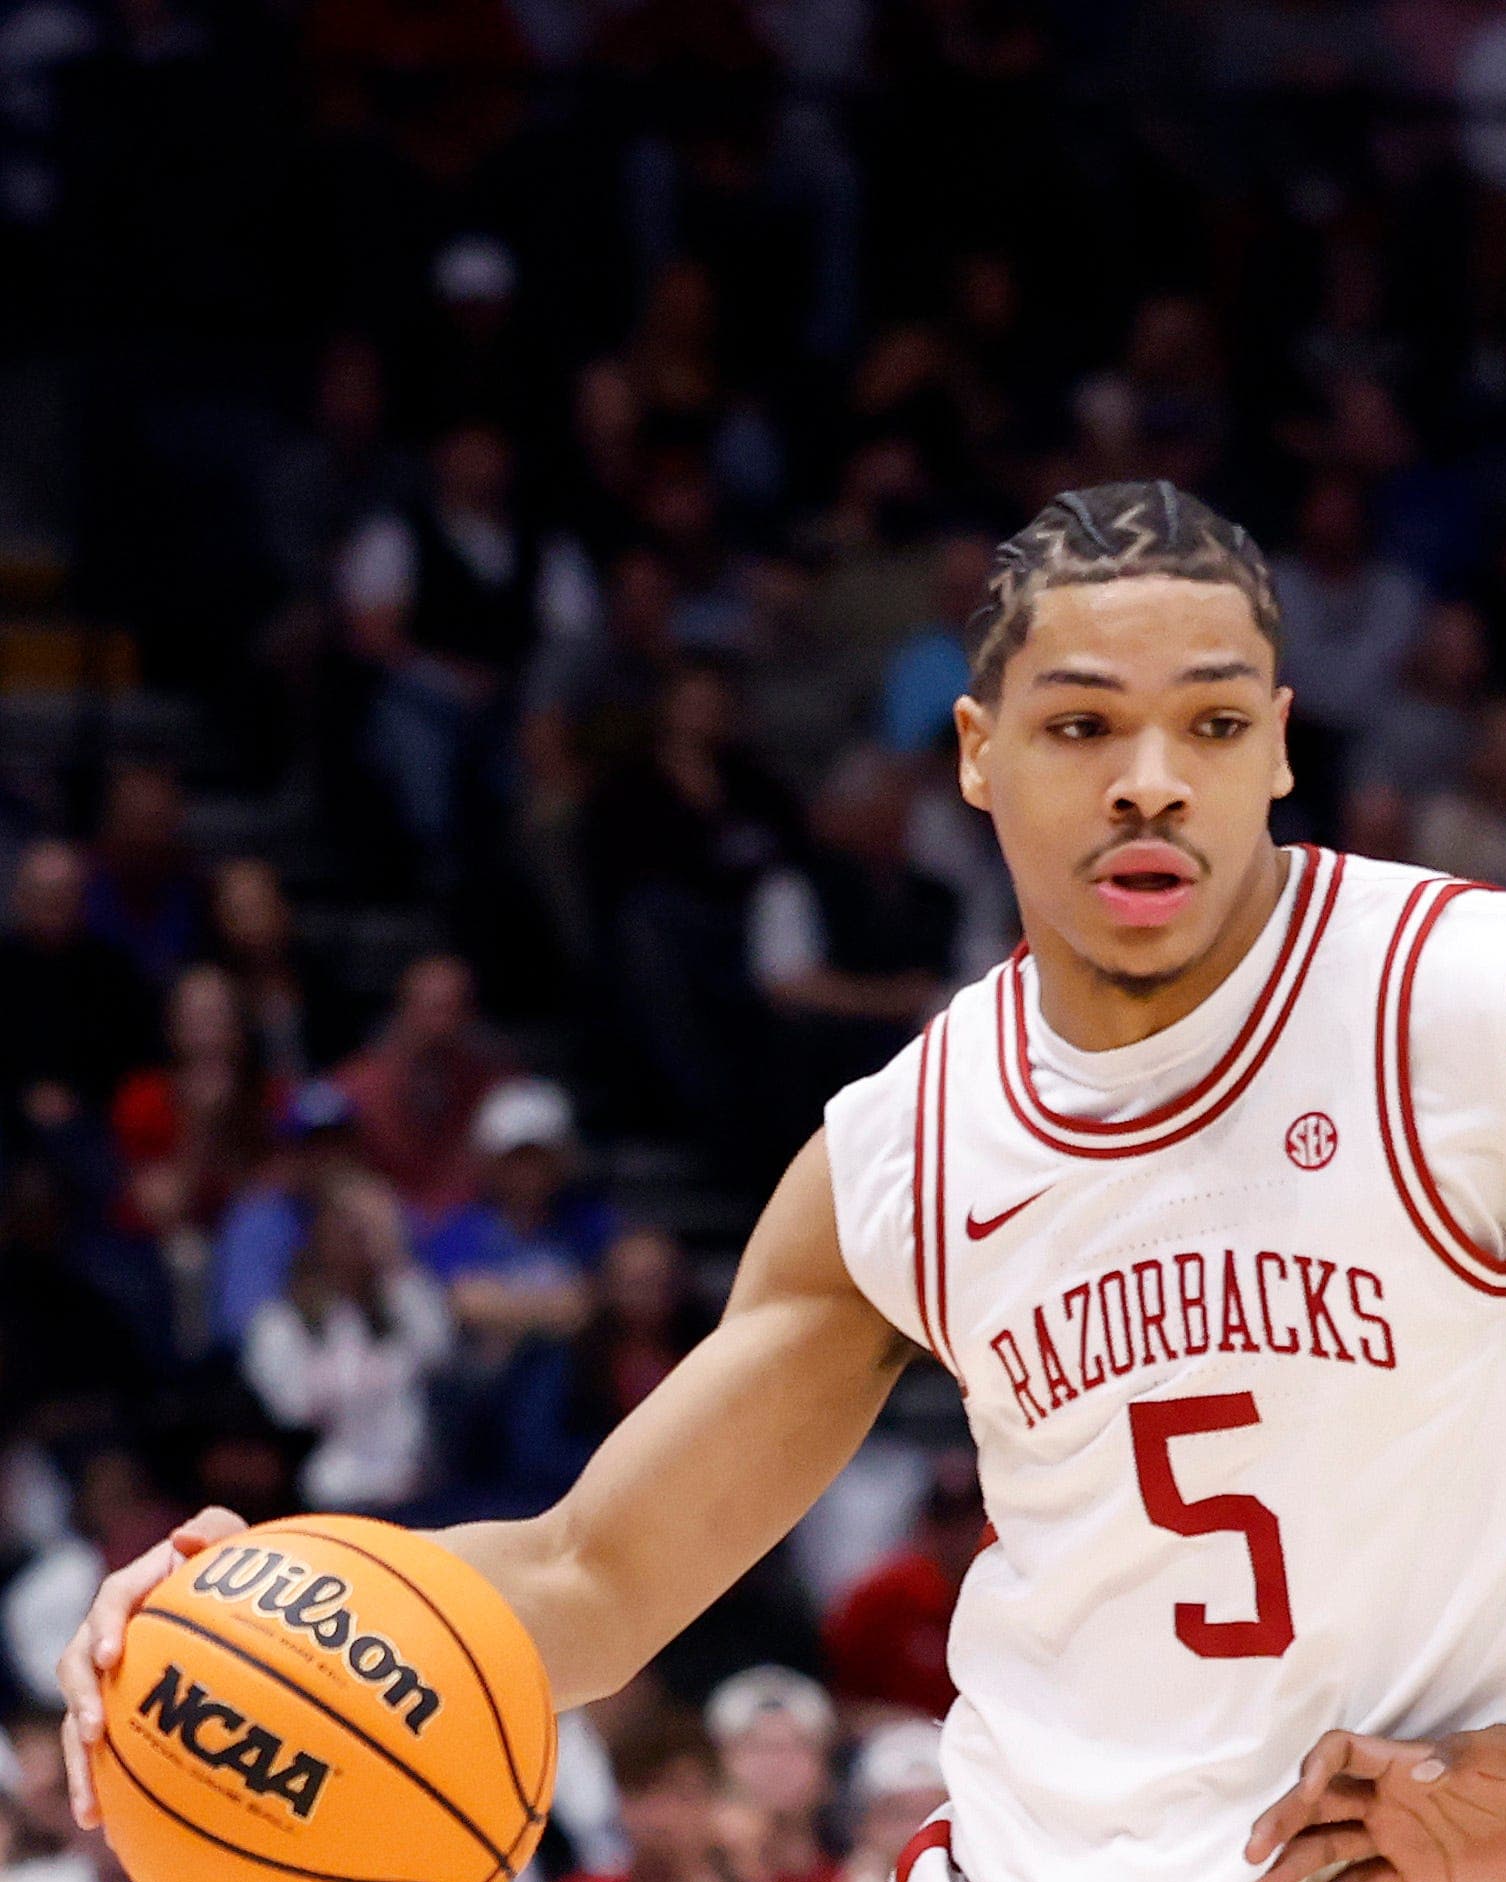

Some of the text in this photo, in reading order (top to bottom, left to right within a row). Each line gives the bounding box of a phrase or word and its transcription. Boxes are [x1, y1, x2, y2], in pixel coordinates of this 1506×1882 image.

[990, 1248, 1397, 1429] RAZORBACKS
[1128, 1390, 1296, 1658] 5
[192, 1546, 444, 1737] Wilson
[138, 1664, 330, 1819] NCAA
